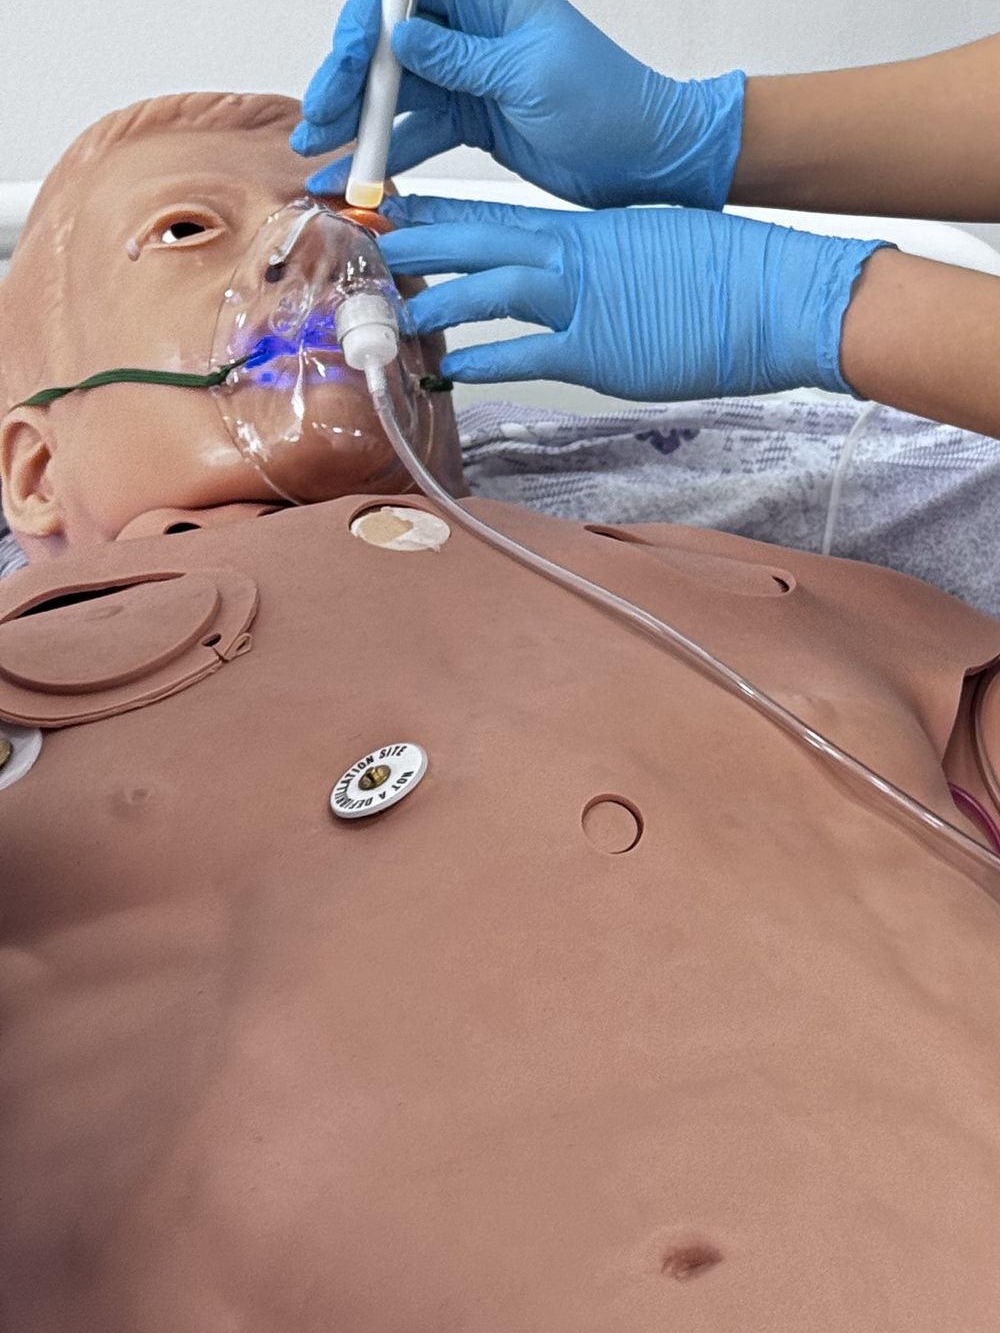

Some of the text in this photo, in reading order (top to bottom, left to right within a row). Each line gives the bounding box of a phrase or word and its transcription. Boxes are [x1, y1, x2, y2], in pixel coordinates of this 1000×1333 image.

[379, 745, 408, 759] SITE
[391, 771, 414, 791] NOT
[378, 791, 387, 800] A
